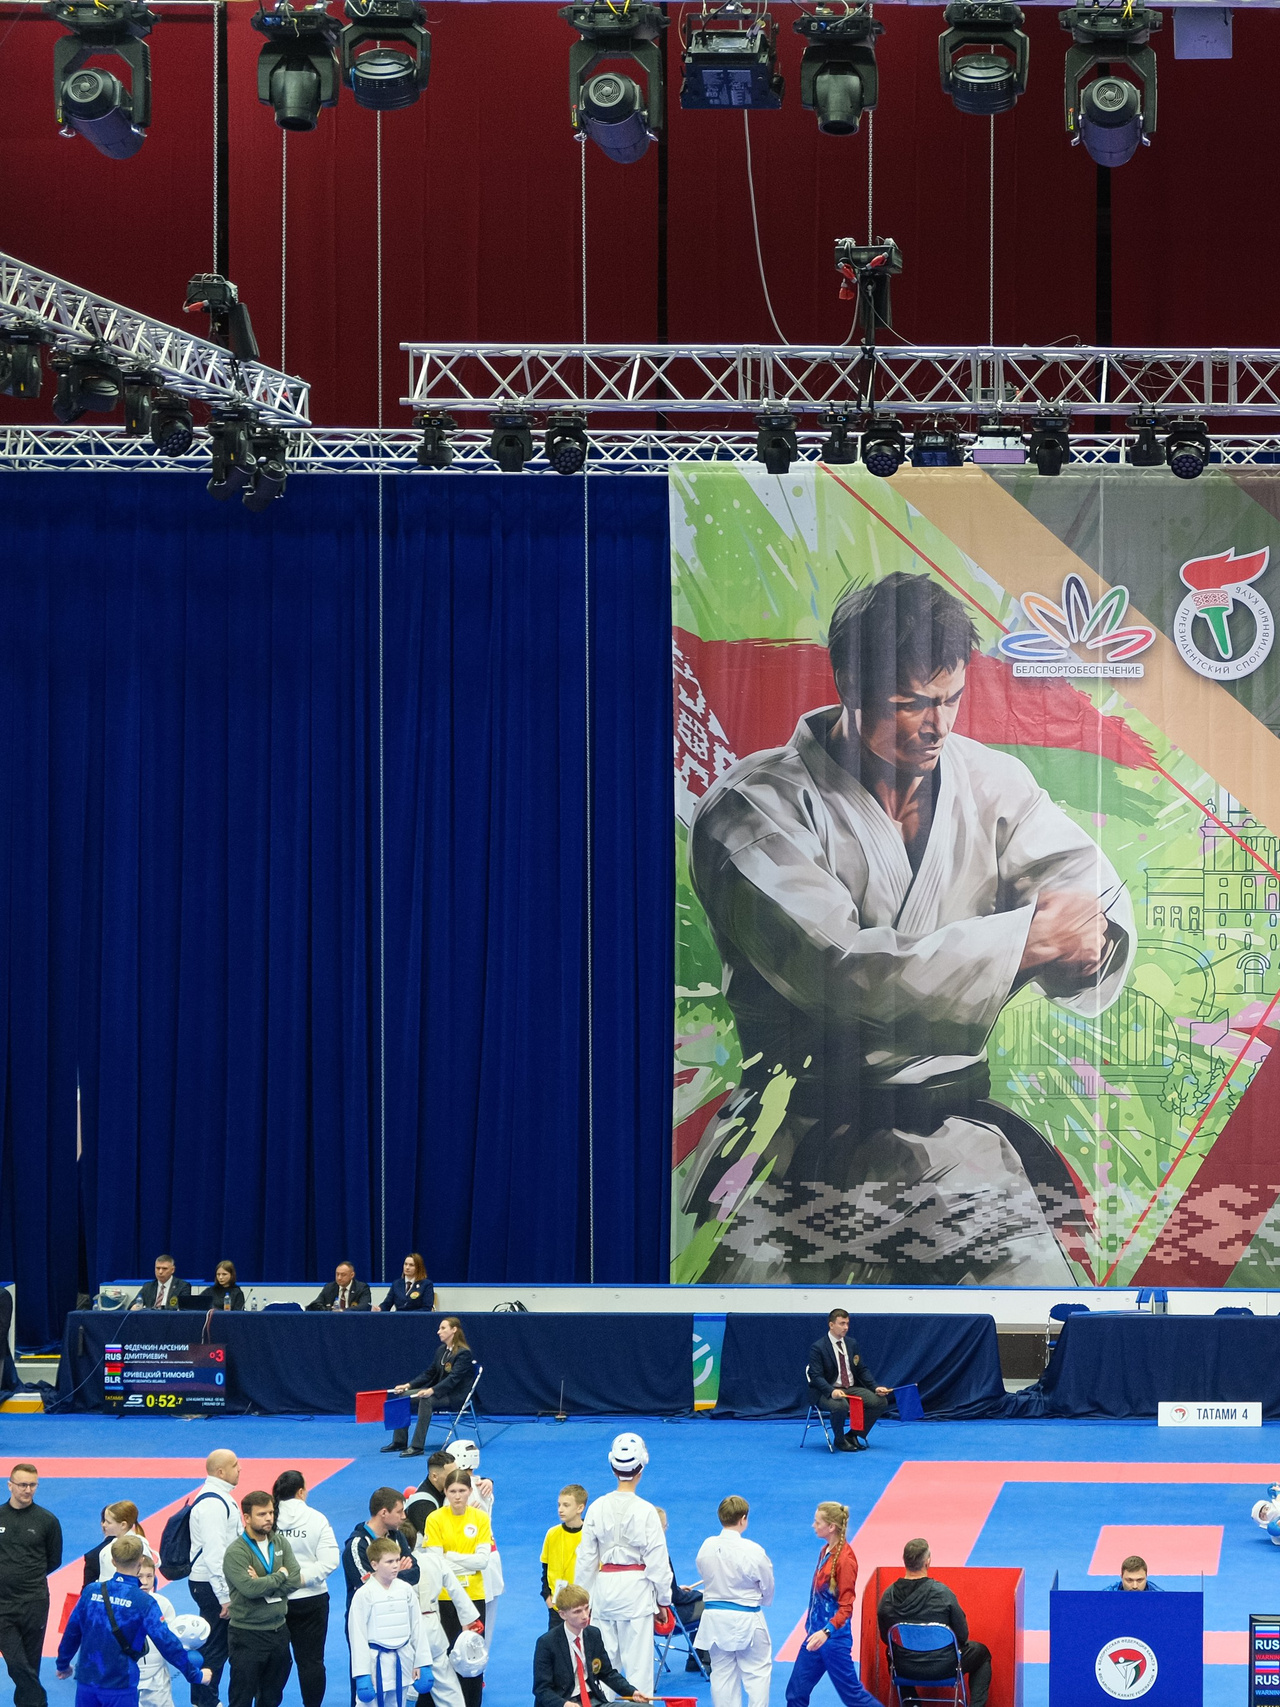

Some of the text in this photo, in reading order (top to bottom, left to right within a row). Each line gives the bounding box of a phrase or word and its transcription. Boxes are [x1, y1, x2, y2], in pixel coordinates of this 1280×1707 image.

[1178, 586, 1270, 674] ПРЕЗИДЕНТСКИЙ СПОРТИВНЫЙ КЛУБ
[1015, 665, 1141, 675] БЕЛСПОРТОБЕСПЕЧЕНИЕ
[105, 1353, 122, 1361] RUS
[215, 1349, 225, 1362] 3
[104, 1376, 121, 1384] BLR
[215, 1372, 224, 1385] 0
[1197, 1408, 1248, 1420] ТАТАМИ 4
[91, 1593, 132, 1608] BEARUS
[1255, 1639, 1280, 1650] RUS
[1255, 1674, 1280, 1685] RUS
